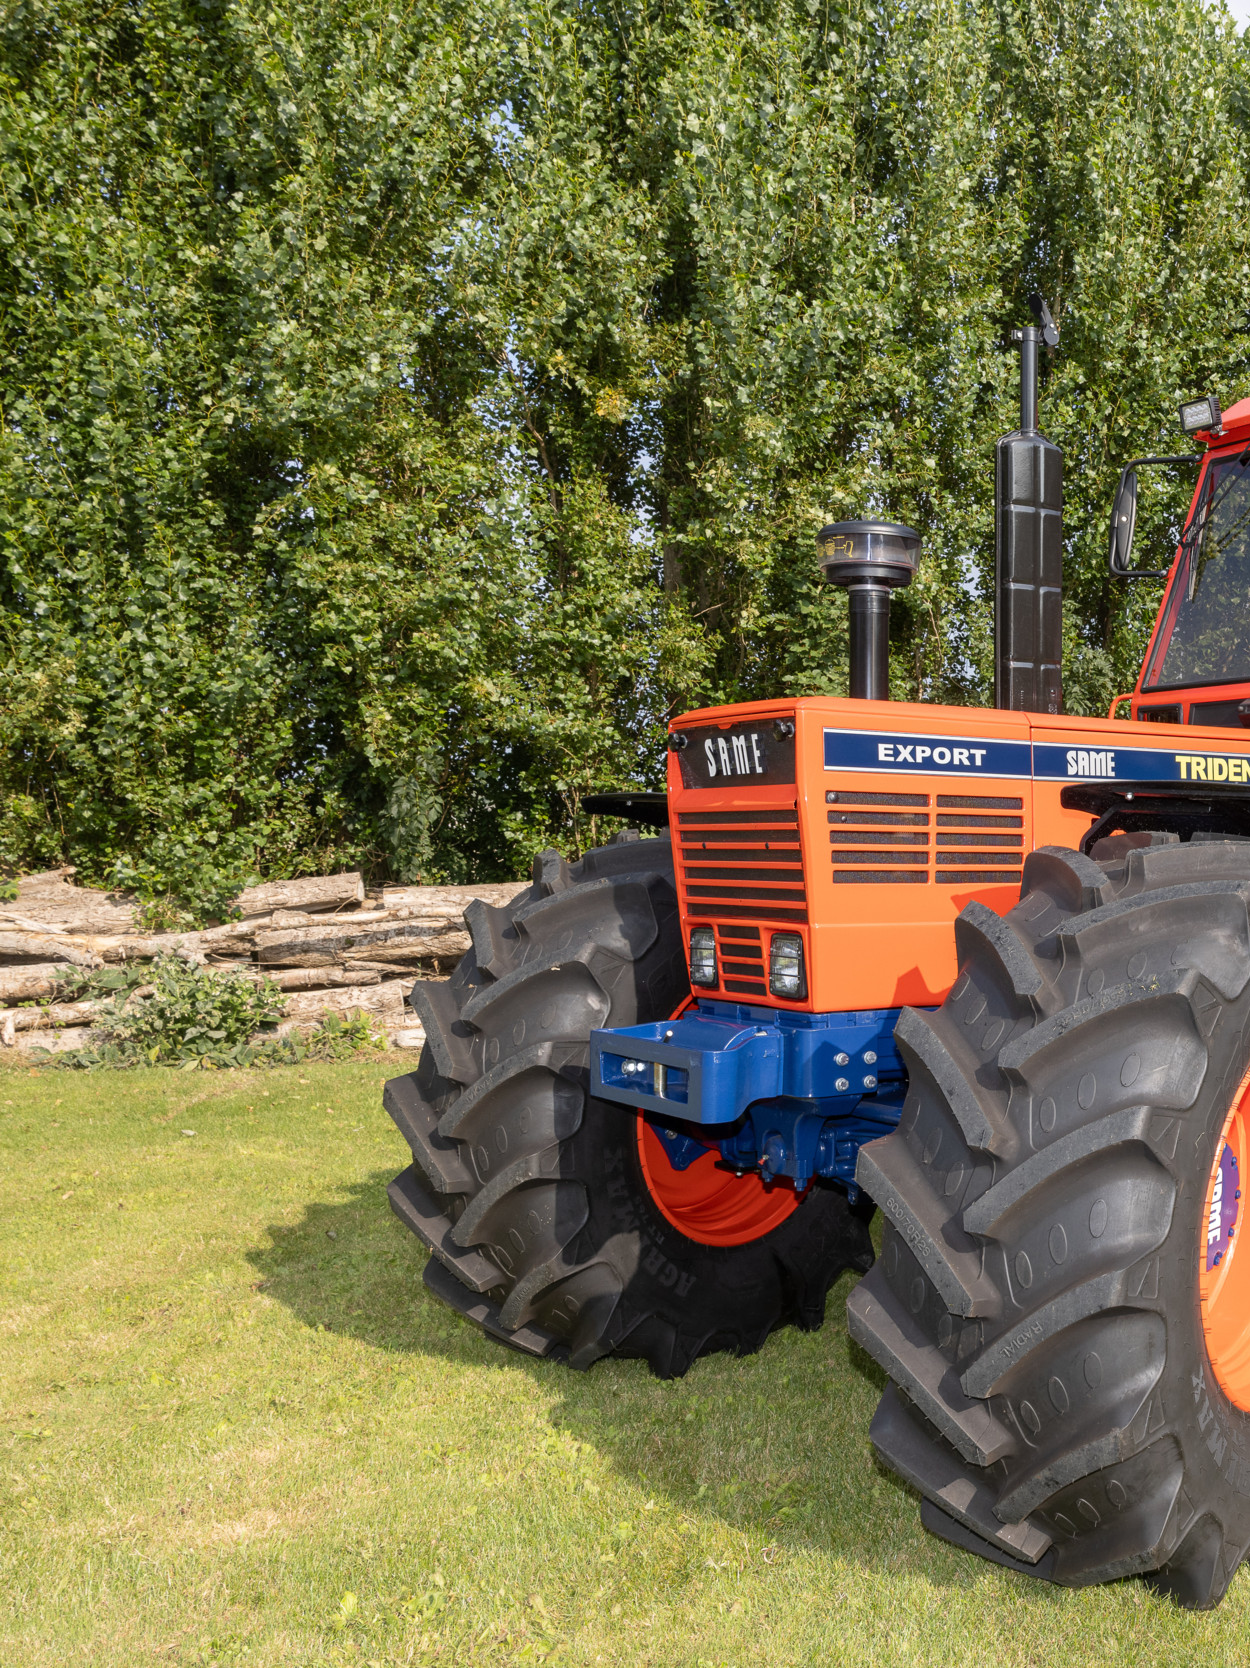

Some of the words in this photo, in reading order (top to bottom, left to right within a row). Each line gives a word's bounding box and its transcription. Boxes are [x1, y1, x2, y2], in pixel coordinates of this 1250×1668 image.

[704, 733, 763, 777] SAME
[877, 743, 987, 767] EXPORT
[1066, 750, 1116, 777] SAME
[886, 1197, 931, 1257] 600/70R28
[1001, 1321, 1043, 1360] RADIAL
